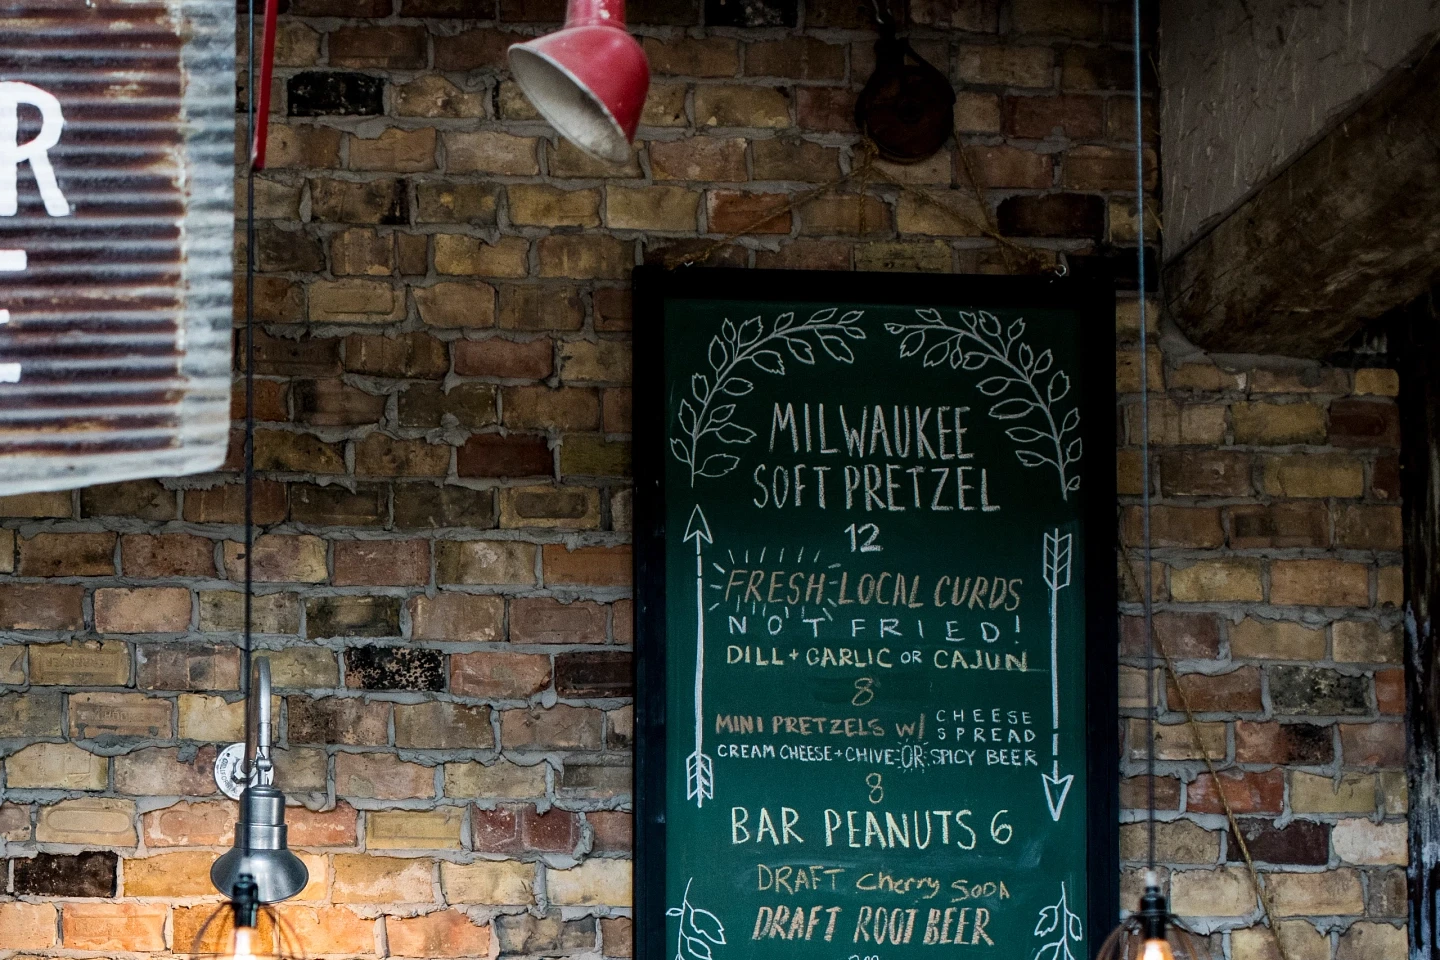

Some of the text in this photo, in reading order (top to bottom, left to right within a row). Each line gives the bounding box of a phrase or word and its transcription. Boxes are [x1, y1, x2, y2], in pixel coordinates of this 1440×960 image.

[769, 402, 975, 460] MILWAUKEE
[753, 463, 1001, 512] SOFT PRETZEL
[844, 523, 884, 552] 12
[725, 569, 1023, 612] FRESH LOCAL CURDS
[728, 614, 1020, 644] NOT FRIED!
[726, 645, 1028, 673] DILL GARLIC OR CAJUN
[851, 677, 874, 706] 8
[715, 713, 764, 735] MINI
[772, 716, 885, 737] PRETZELS
[936, 708, 1033, 725] CHEESE
[937, 727, 1036, 743] SPREAD
[717, 744, 775, 758] CREAM
[780, 746, 832, 762] CHEESE
[901, 745, 923, 768] OR
[930, 749, 976, 766] SPICY
[986, 749, 1038, 766] BEER
[865, 772, 884, 804] 8
[731, 806, 1013, 850] BAR PEANUTS 6
[757, 864, 845, 895] DRAFT
[751, 905, 995, 946] DRAFT ROOT BEER
